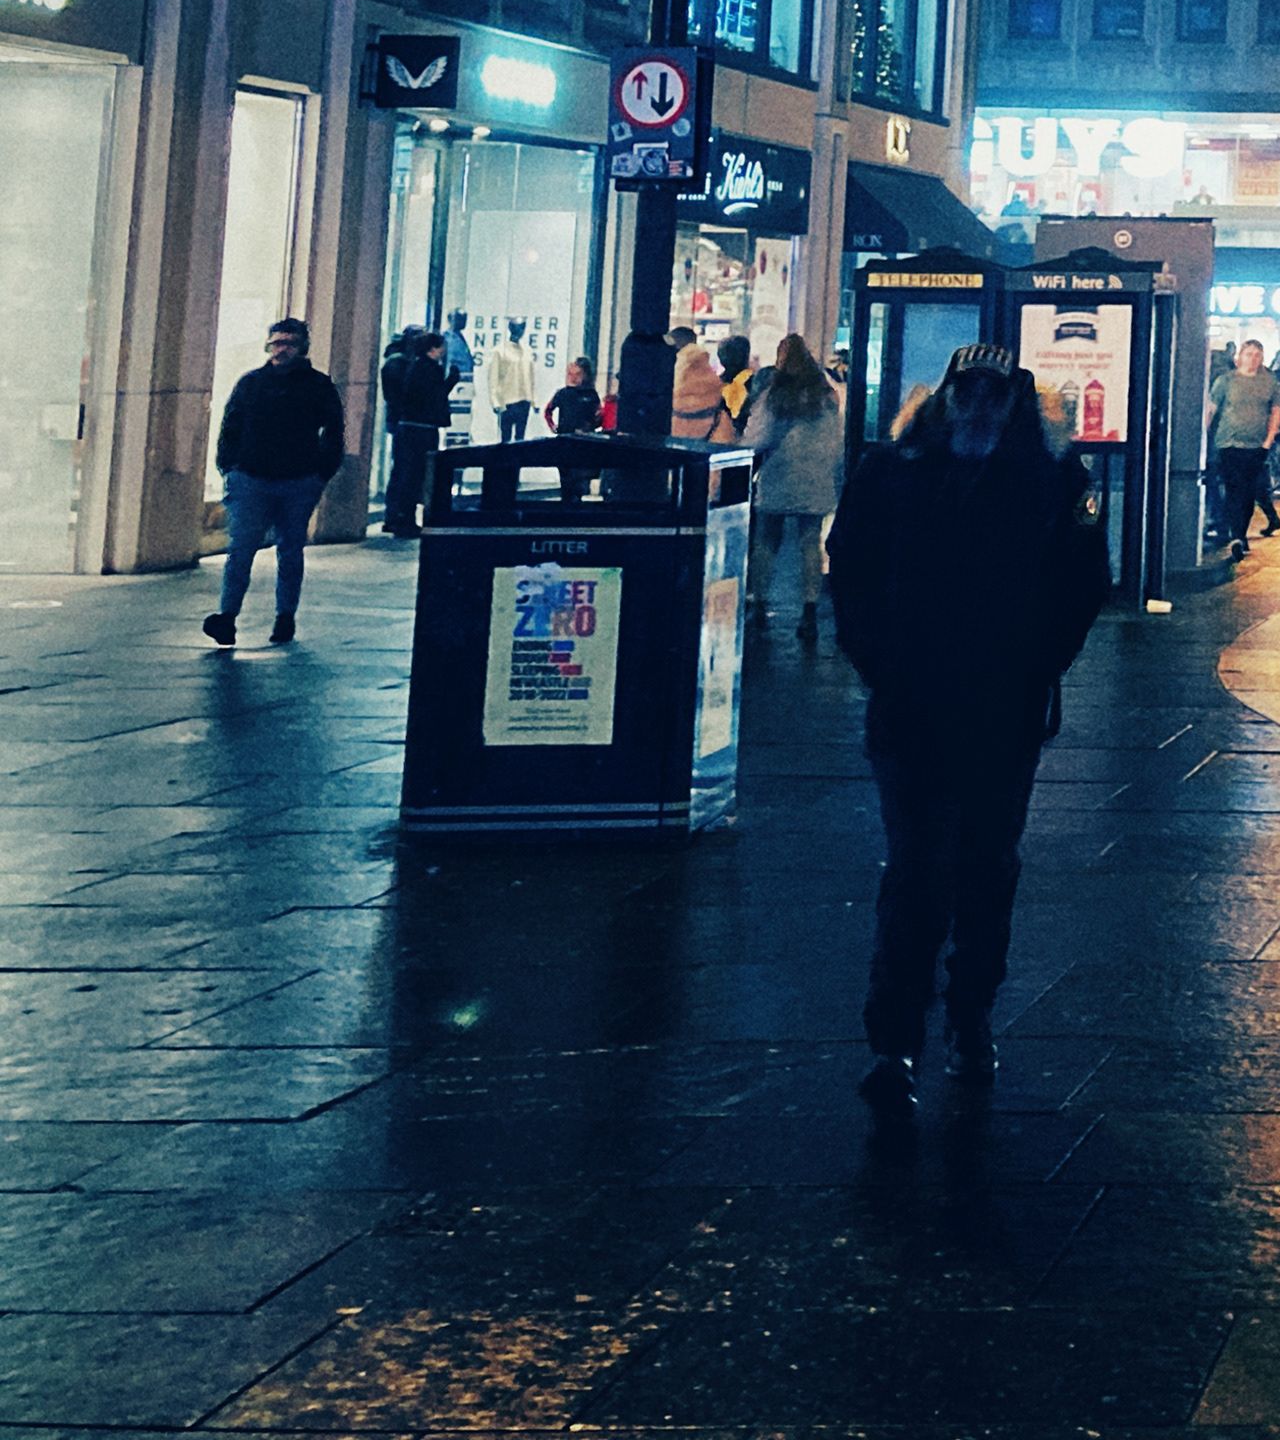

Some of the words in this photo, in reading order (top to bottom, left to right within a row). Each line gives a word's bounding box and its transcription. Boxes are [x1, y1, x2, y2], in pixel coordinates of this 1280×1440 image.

[878, 274, 975, 287] TELEPHONE
[1032, 275, 1066, 289] WiFi
[1072, 275, 1105, 289] here
[475, 316, 558, 330] BEER
[474, 333, 557, 349] NEER
[531, 541, 588, 554] LITTER
[513, 605, 597, 638] ZERO
[511, 664, 561, 676] SLEEPING
[509, 676, 569, 688] NEWCASTLE
